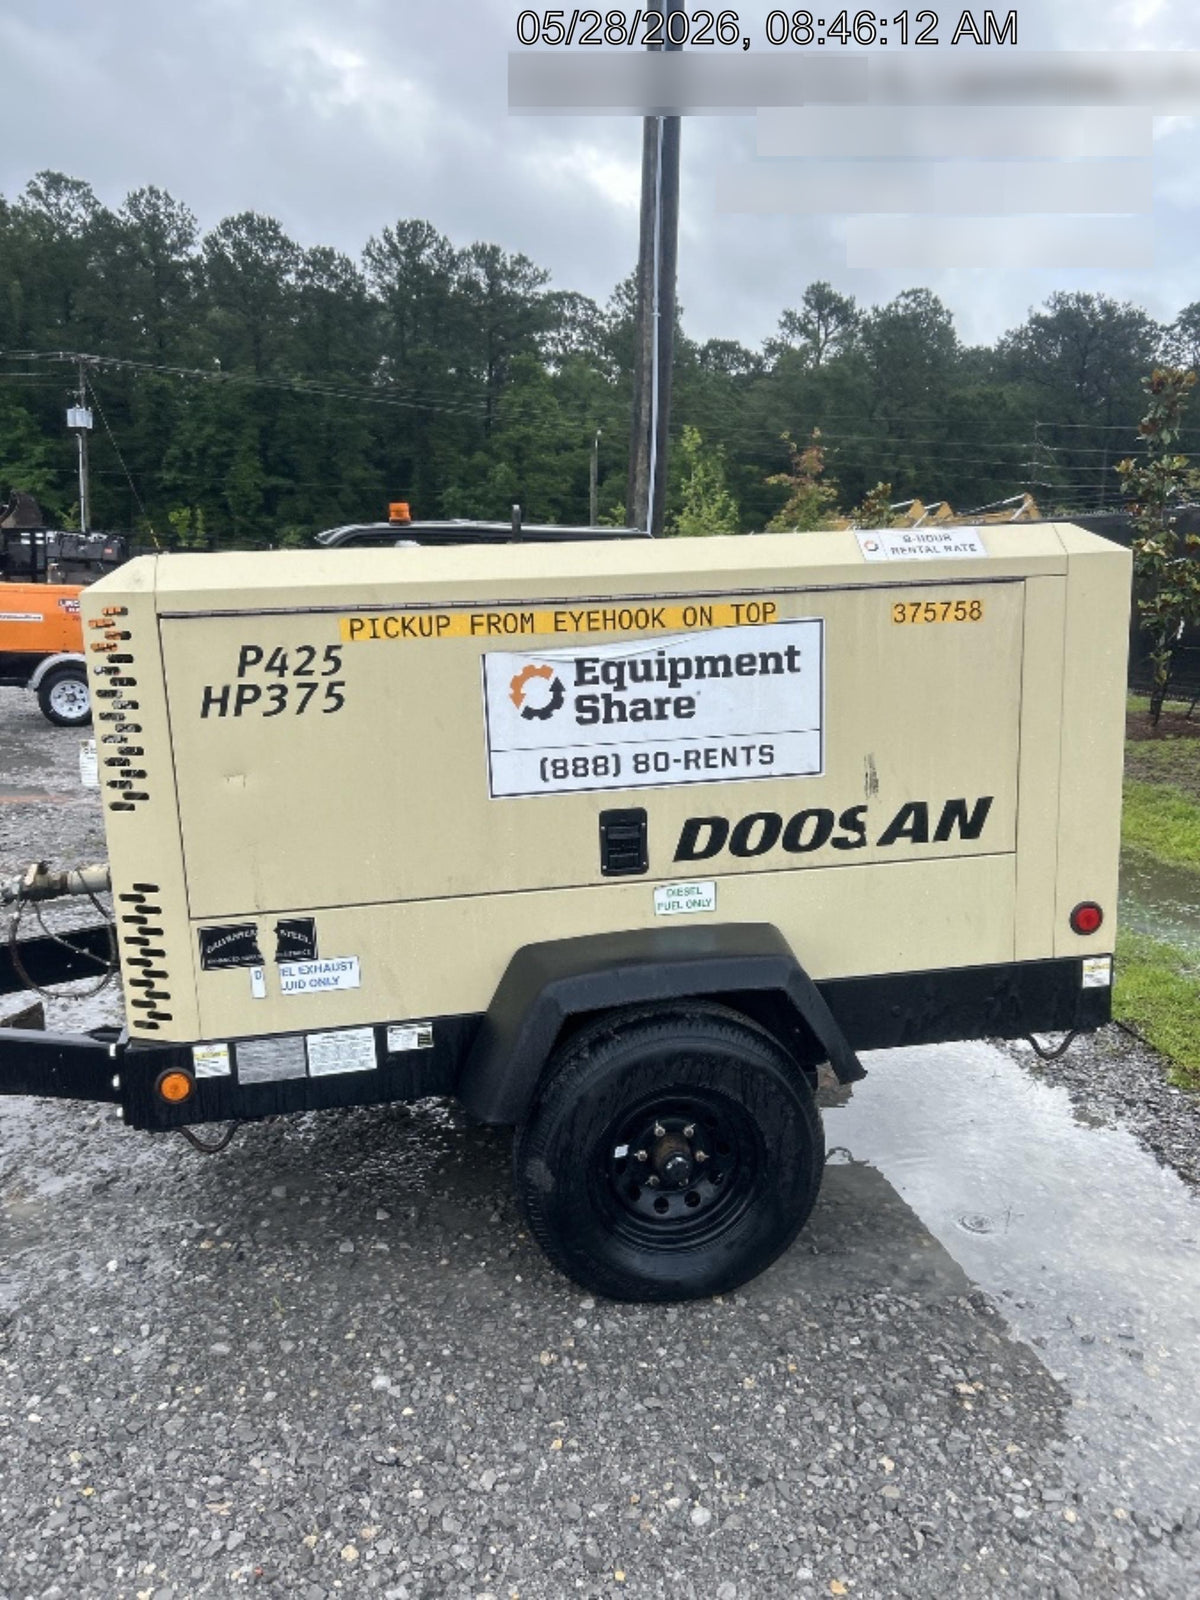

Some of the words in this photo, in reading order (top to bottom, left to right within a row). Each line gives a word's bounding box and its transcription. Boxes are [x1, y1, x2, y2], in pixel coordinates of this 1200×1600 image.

[890, 545, 941, 556] RENTAL
[943, 543, 977, 553] RATE
[350, 615, 451, 640] PICKUP
[470, 613, 535, 635] FROM
[553, 608, 666, 633] EYEHOOK
[682, 606, 713, 627] ON
[730, 602, 777, 624] TOP
[893, 600, 983, 623] 375758
[236, 644, 343, 678] P425
[573, 644, 801, 692] Equipment
[199, 680, 346, 719] HP375
[574, 691, 697, 726] Share
[539, 753, 622, 783] (888)
[632, 744, 775, 775] 80-RENTS
[672, 796, 995, 863] DOOSAN
[657, 901, 683, 911] FUEL
[685, 898, 712, 909] ONLY
[665, 886, 704, 898] DIESEL
[300, 961, 354, 976] EXHAUST
[310, 975, 341, 988] ONLY
